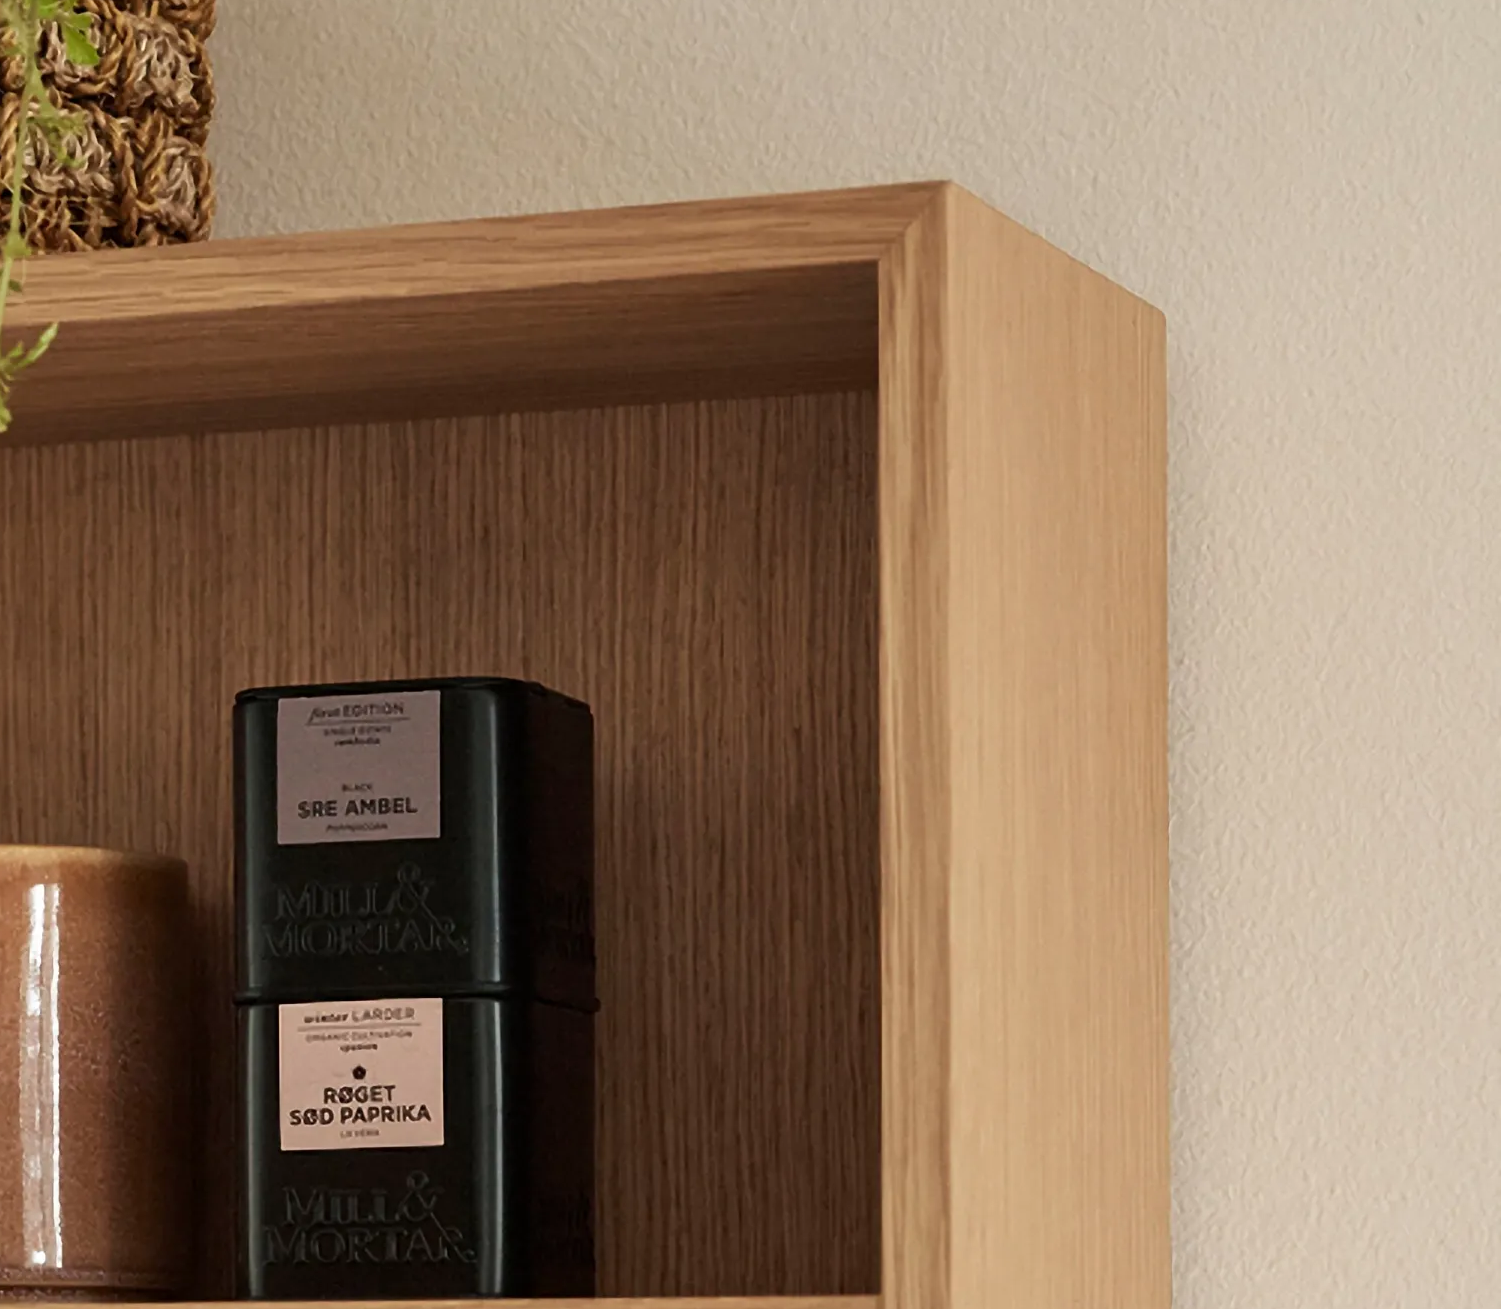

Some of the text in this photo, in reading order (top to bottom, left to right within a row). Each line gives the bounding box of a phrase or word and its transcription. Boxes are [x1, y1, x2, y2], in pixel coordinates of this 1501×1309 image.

[343, 702, 404, 718] EDITION
[298, 797, 418, 819] SRE AMBEL
[351, 1007, 416, 1023] LARDER
[323, 1085, 396, 1104] RØGET
[289, 1104, 432, 1126] SØD PAPRIKA
[261, 1224, 479, 1264] MORTAR
